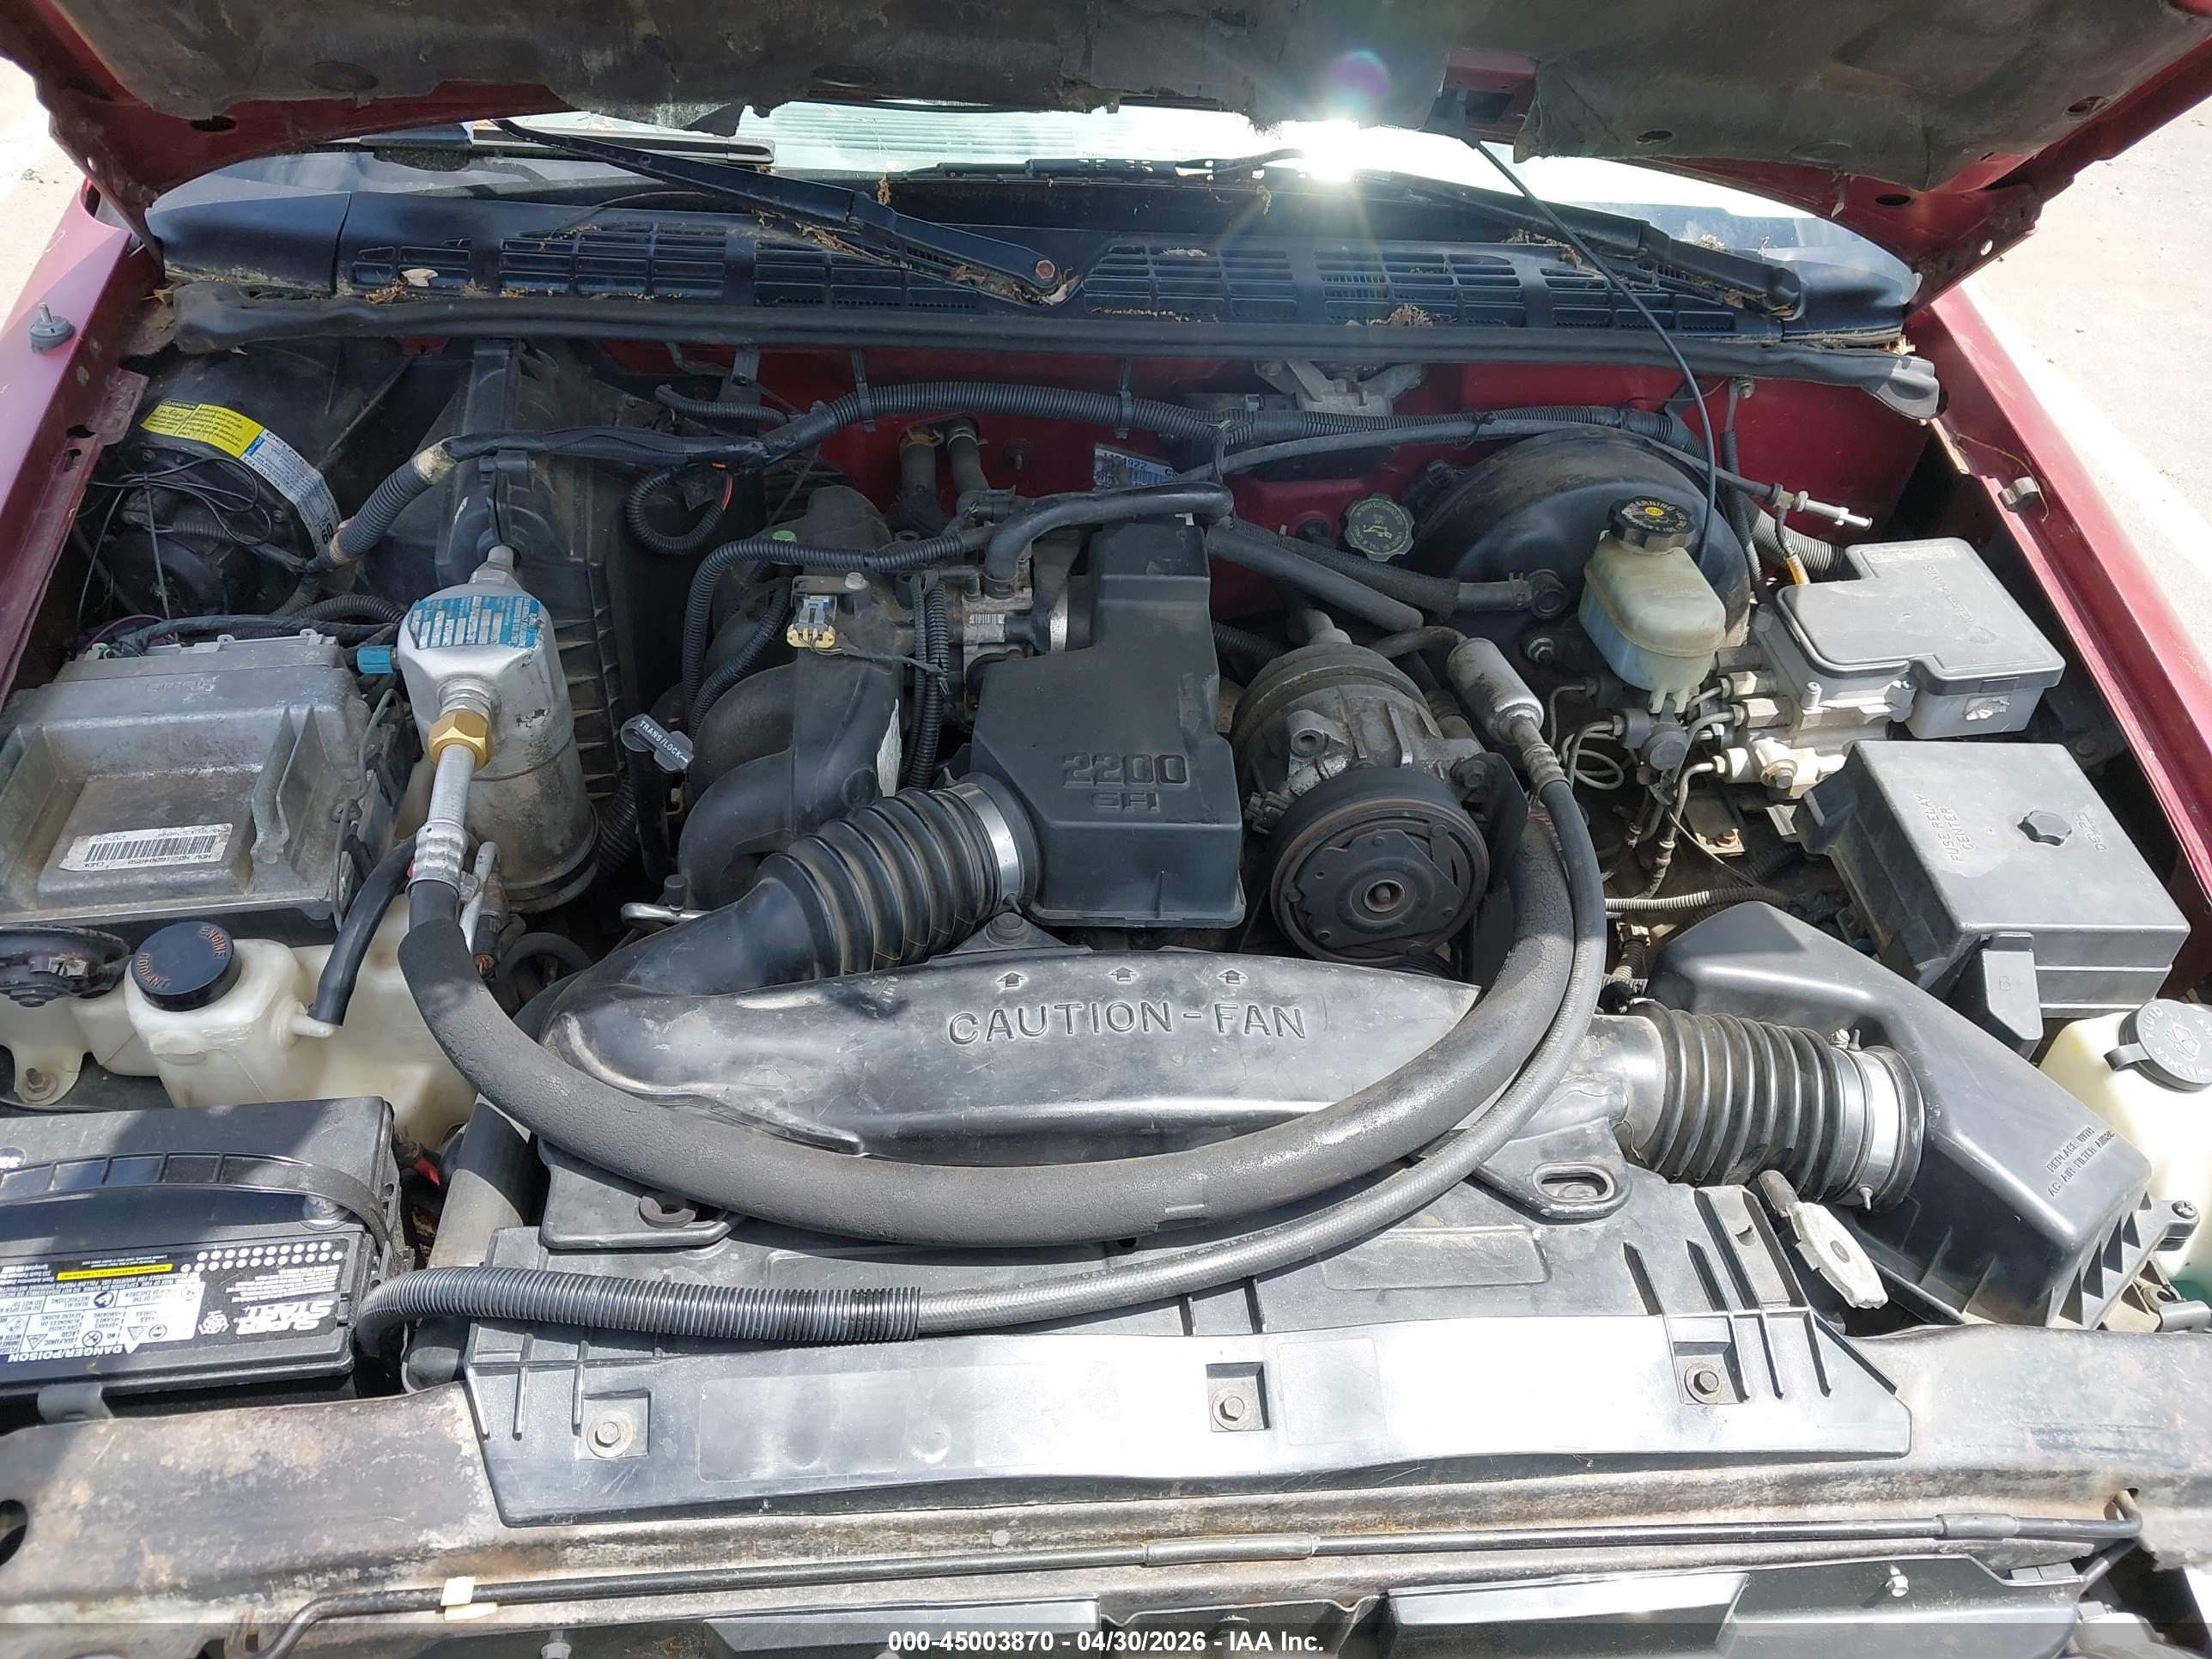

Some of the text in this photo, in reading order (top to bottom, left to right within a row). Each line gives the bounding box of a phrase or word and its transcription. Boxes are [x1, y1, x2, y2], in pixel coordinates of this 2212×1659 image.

[266, 431, 307, 465] DELPHI
[639, 720, 682, 759] TRANS/LOCK
[1062, 751, 1189, 789] 2200
[1092, 791, 1160, 813] SFI
[1916, 794, 1965, 861] FUSE RELAY
[1939, 806, 1973, 850] CENTER
[198, 926, 228, 959] ENGINE
[139, 951, 170, 988] COOLANT
[2143, 1006, 2164, 1040] FLUID
[2154, 1046, 2207, 1079] WASHER
[2046, 1126, 2095, 1173] REPLACE WITH
[2048, 1182, 2062, 1197] AC
[2061, 1166, 2077, 1183] AIR
[2073, 1147, 2097, 1169] FILTER
[236, 1317, 323, 1334] SUPER
[245, 1300, 335, 1320] START
[7, 1345, 123, 1362] DANGER/POISON
